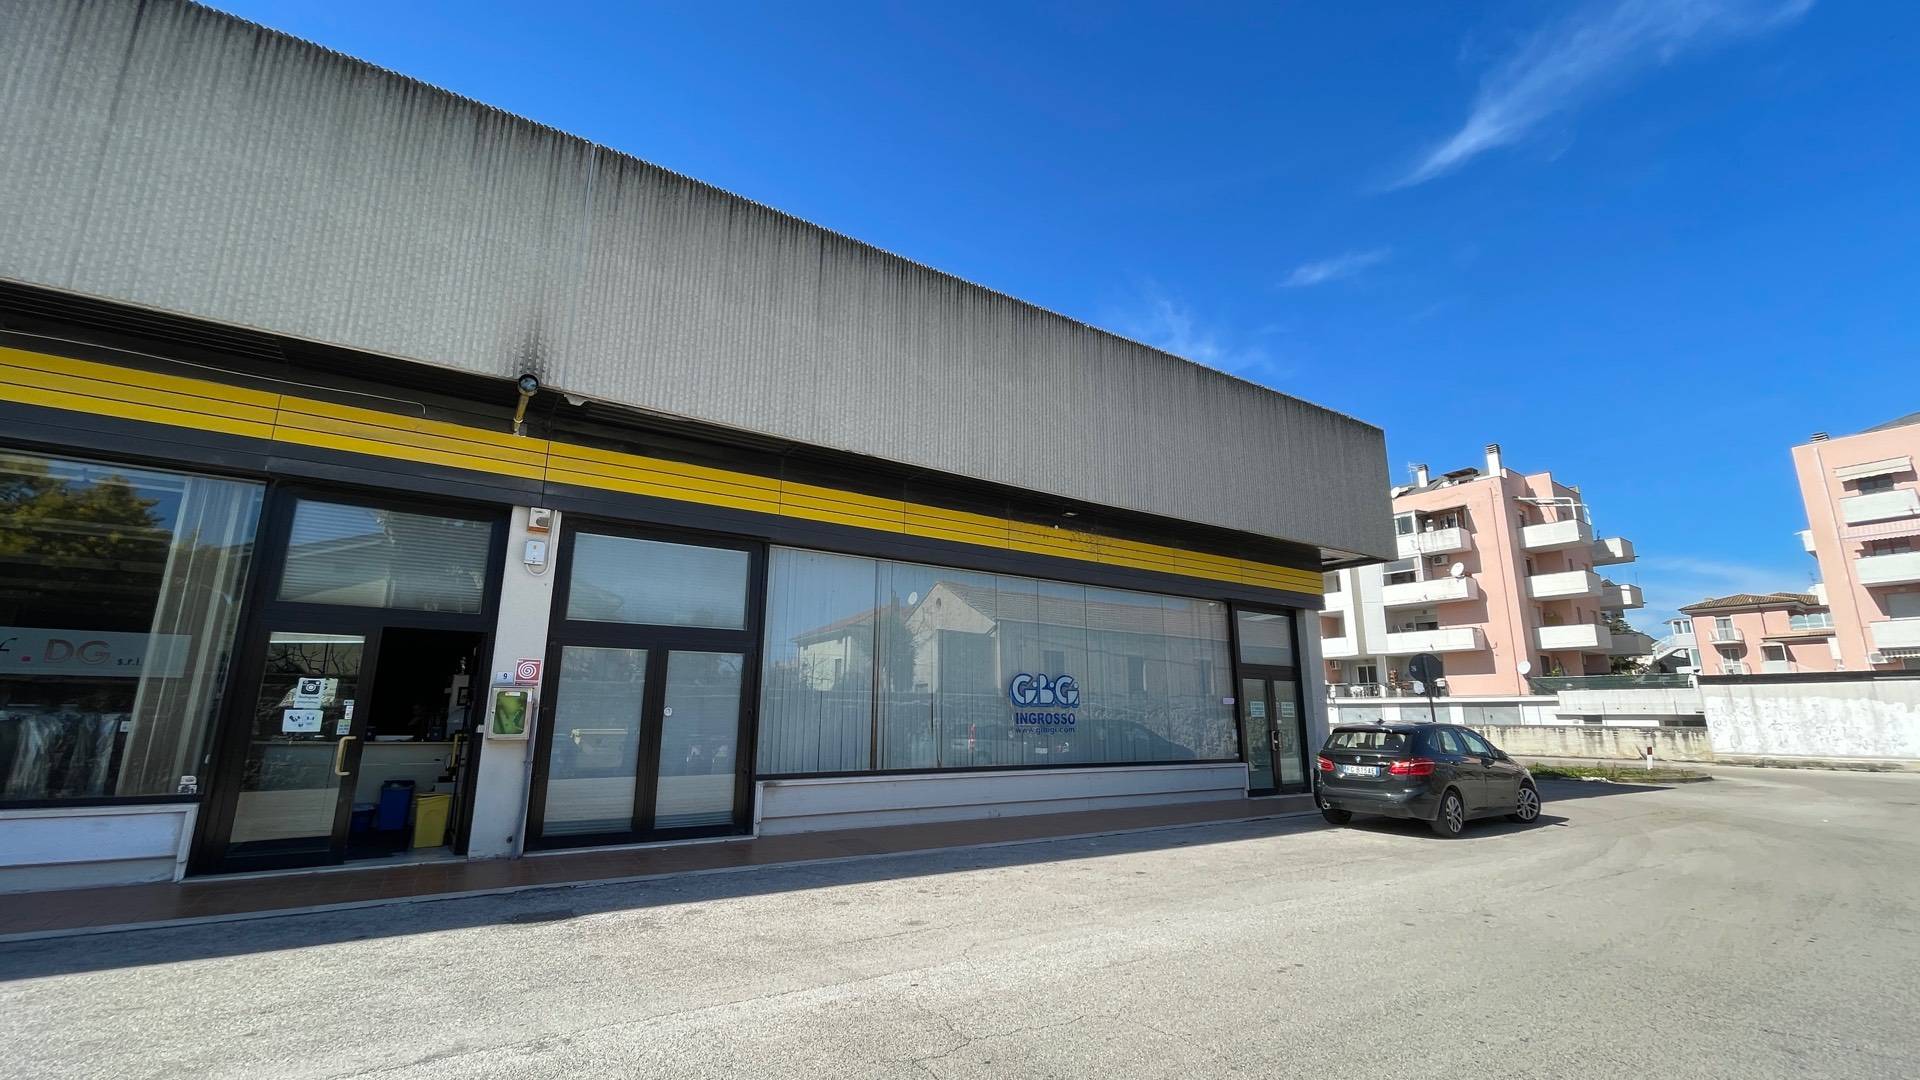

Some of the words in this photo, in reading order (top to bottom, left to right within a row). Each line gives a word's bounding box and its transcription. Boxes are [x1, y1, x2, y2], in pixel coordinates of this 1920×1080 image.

[43, 638, 112, 665] DG
[503, 672, 508, 680] 9
[1015, 712, 1076, 725] INGROSSO
